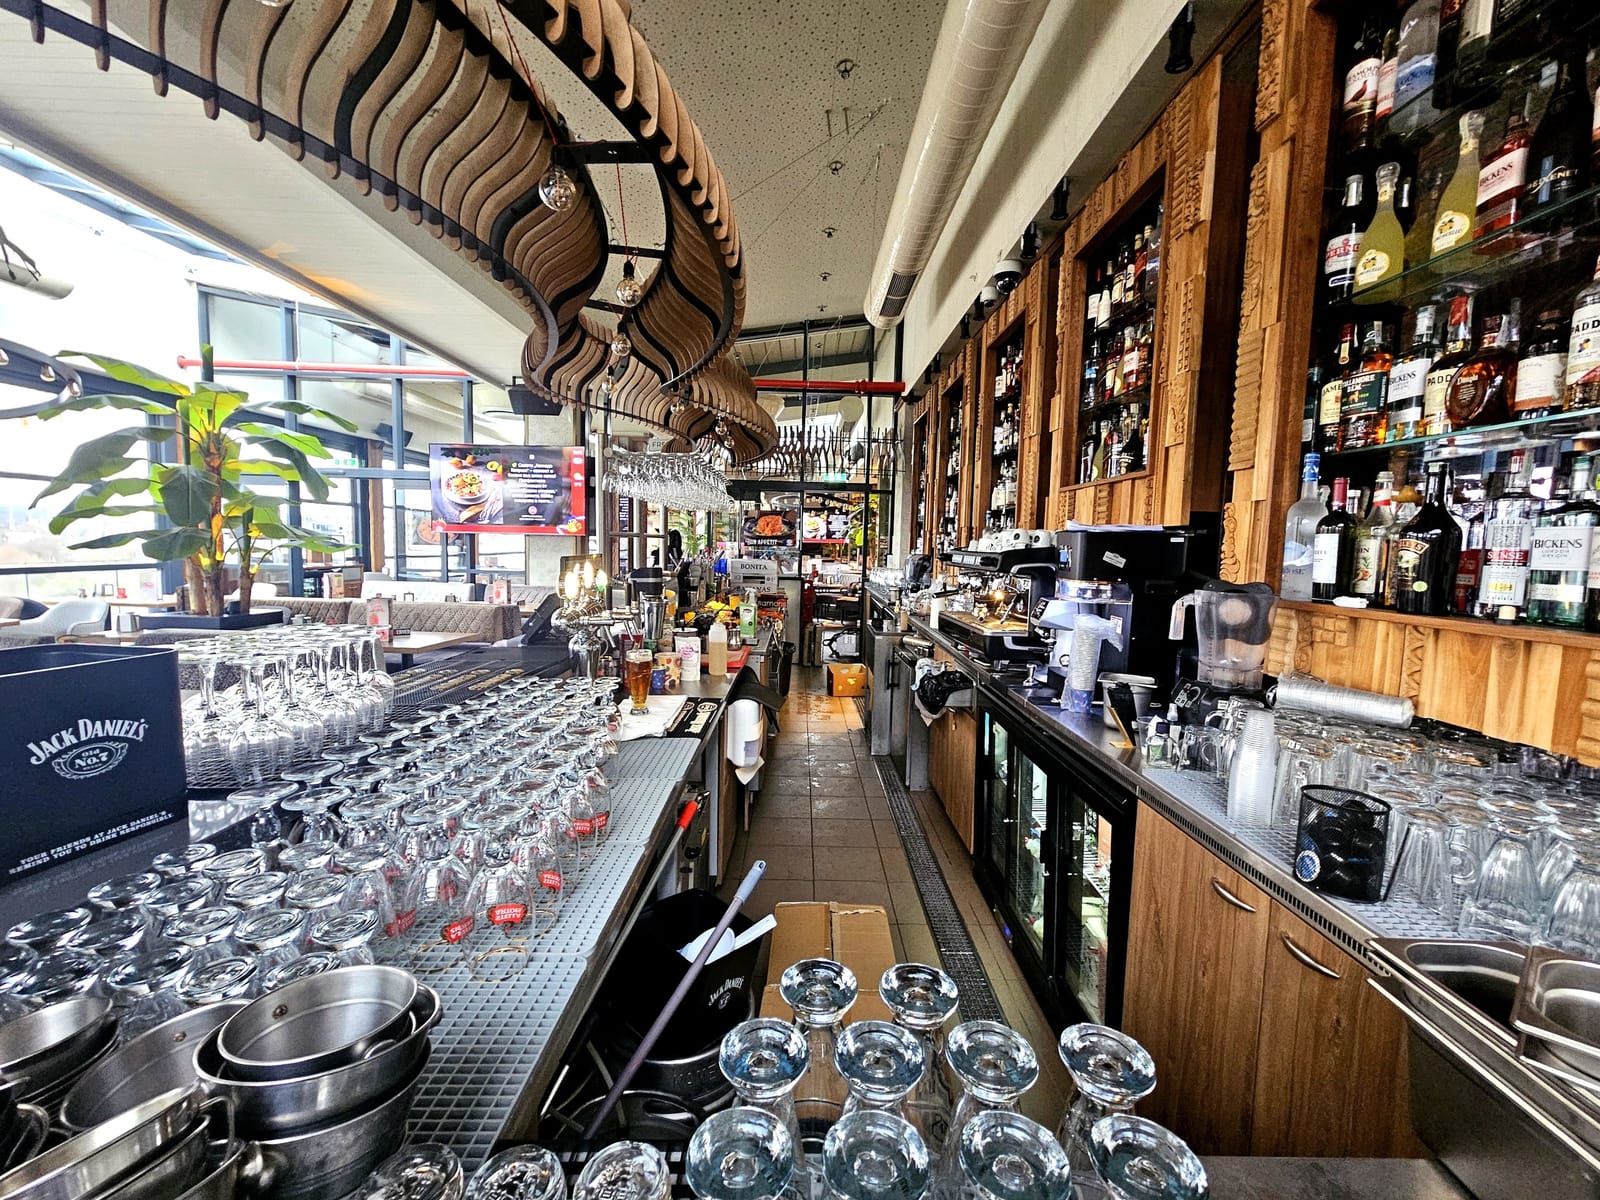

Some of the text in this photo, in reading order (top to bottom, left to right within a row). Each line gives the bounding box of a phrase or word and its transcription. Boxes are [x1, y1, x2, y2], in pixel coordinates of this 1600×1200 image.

[1571, 319, 1600, 334] PADD
[1427, 373, 1452, 387] PADD
[1322, 383, 1342, 397] JAME
[1534, 539, 1583, 549] BICKENS
[1487, 551, 1524, 559] SENSE
[26, 718, 149, 765] JACK DANIEL'S
[81, 749, 100, 757] Old
[19, 810, 168, 865] YOUR FRIENDS AT JACK DANIEL'S
[8, 856, 50, 876] REMIND
[52, 848, 73, 860] YOU
[75, 844, 87, 853] TO
[89, 832, 118, 847] DRINK
